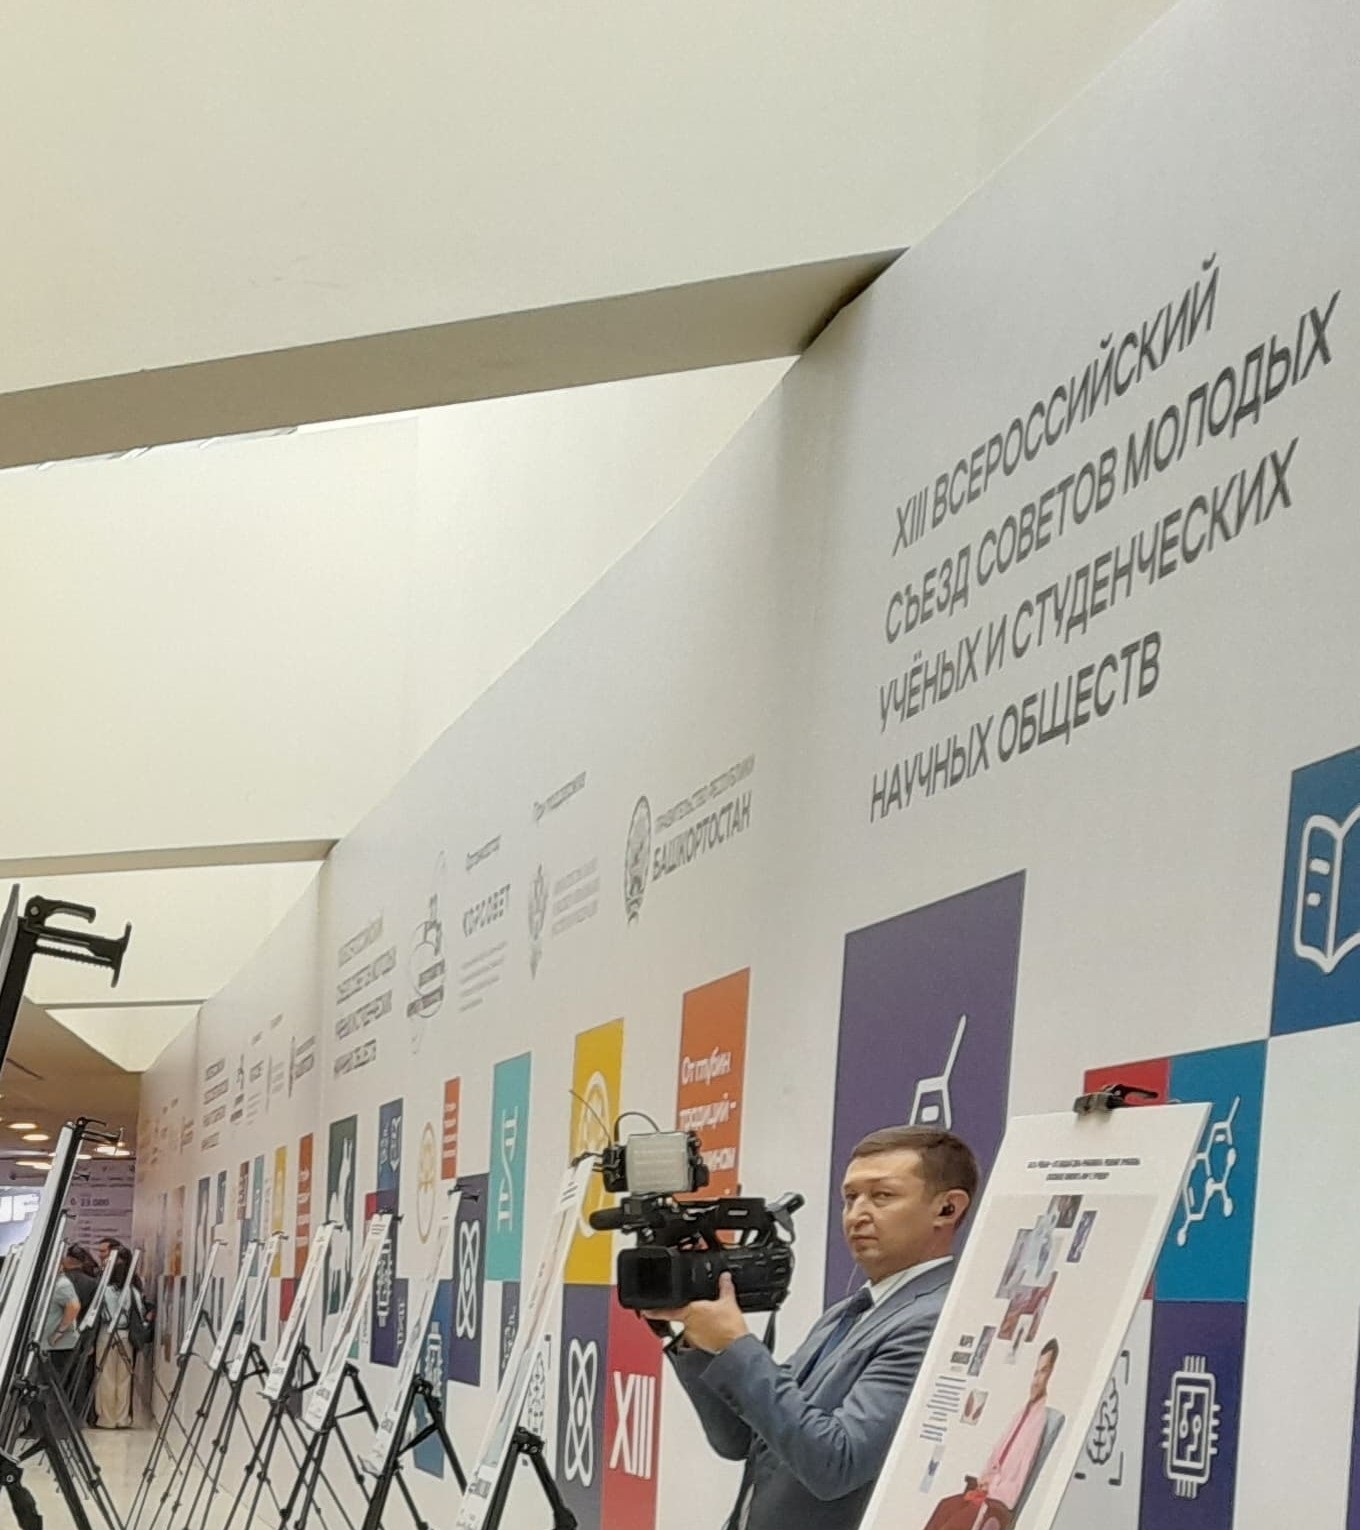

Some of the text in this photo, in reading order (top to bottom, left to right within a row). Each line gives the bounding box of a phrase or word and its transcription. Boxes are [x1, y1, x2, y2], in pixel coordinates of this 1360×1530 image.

[885, 289, 1342, 645] СЪЕЗД СОВЕТОВ МОЛОДЫХ
[892, 251, 1220, 557] XIII ВСЕРОССИЙСКИЙ
[869, 714, 995, 824] НАУЧНЫХ
[997, 630, 1162, 764] ОБЩЕСТВ
[879, 436, 1300, 735] УЧЁНЫХ И СТУДЕНЧЕСКИХ
[608, 1370, 657, 1481] XIII
